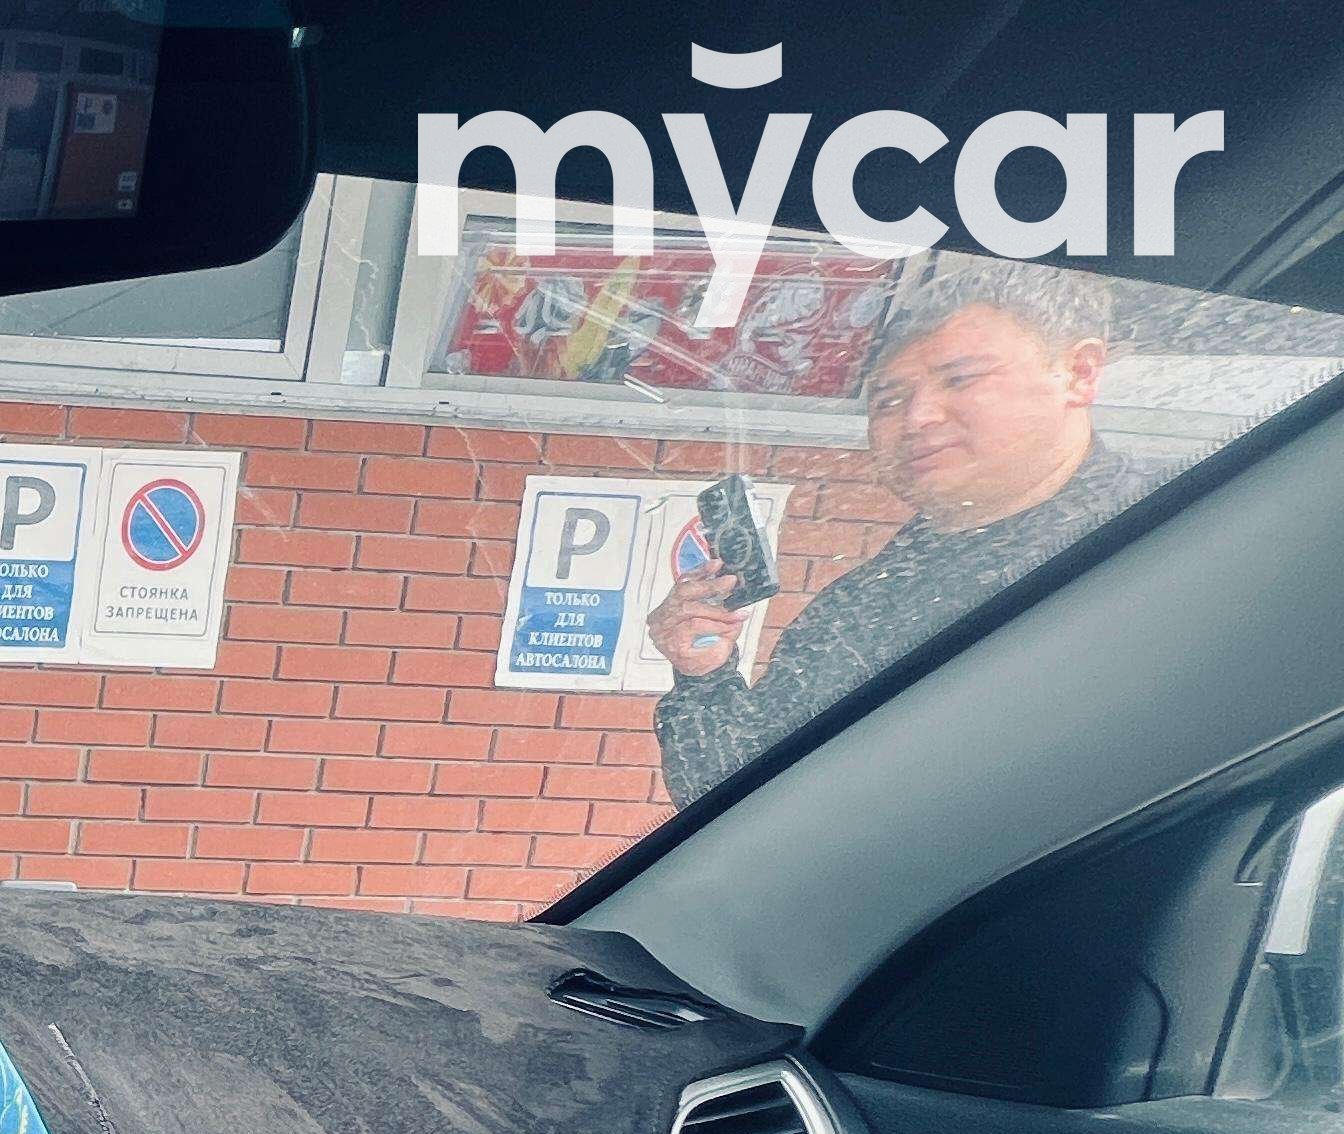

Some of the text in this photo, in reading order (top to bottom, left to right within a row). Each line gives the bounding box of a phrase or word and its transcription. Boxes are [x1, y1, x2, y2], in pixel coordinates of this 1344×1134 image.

[0, 475, 56, 550] P
[556, 507, 611, 580] P
[1, 584, 33, 600] ДЛЯ
[119, 586, 189, 600] СТОЯНКА
[544, 591, 600, 607] ТОЛЬКО
[104, 605, 198, 621] ЗАПРЕЩЕНА
[554, 612, 586, 627] ДЛЯ
[528, 632, 603, 648] КЛИЕНТОВ
[515, 653, 606, 669] АВТОСАЛОНА
